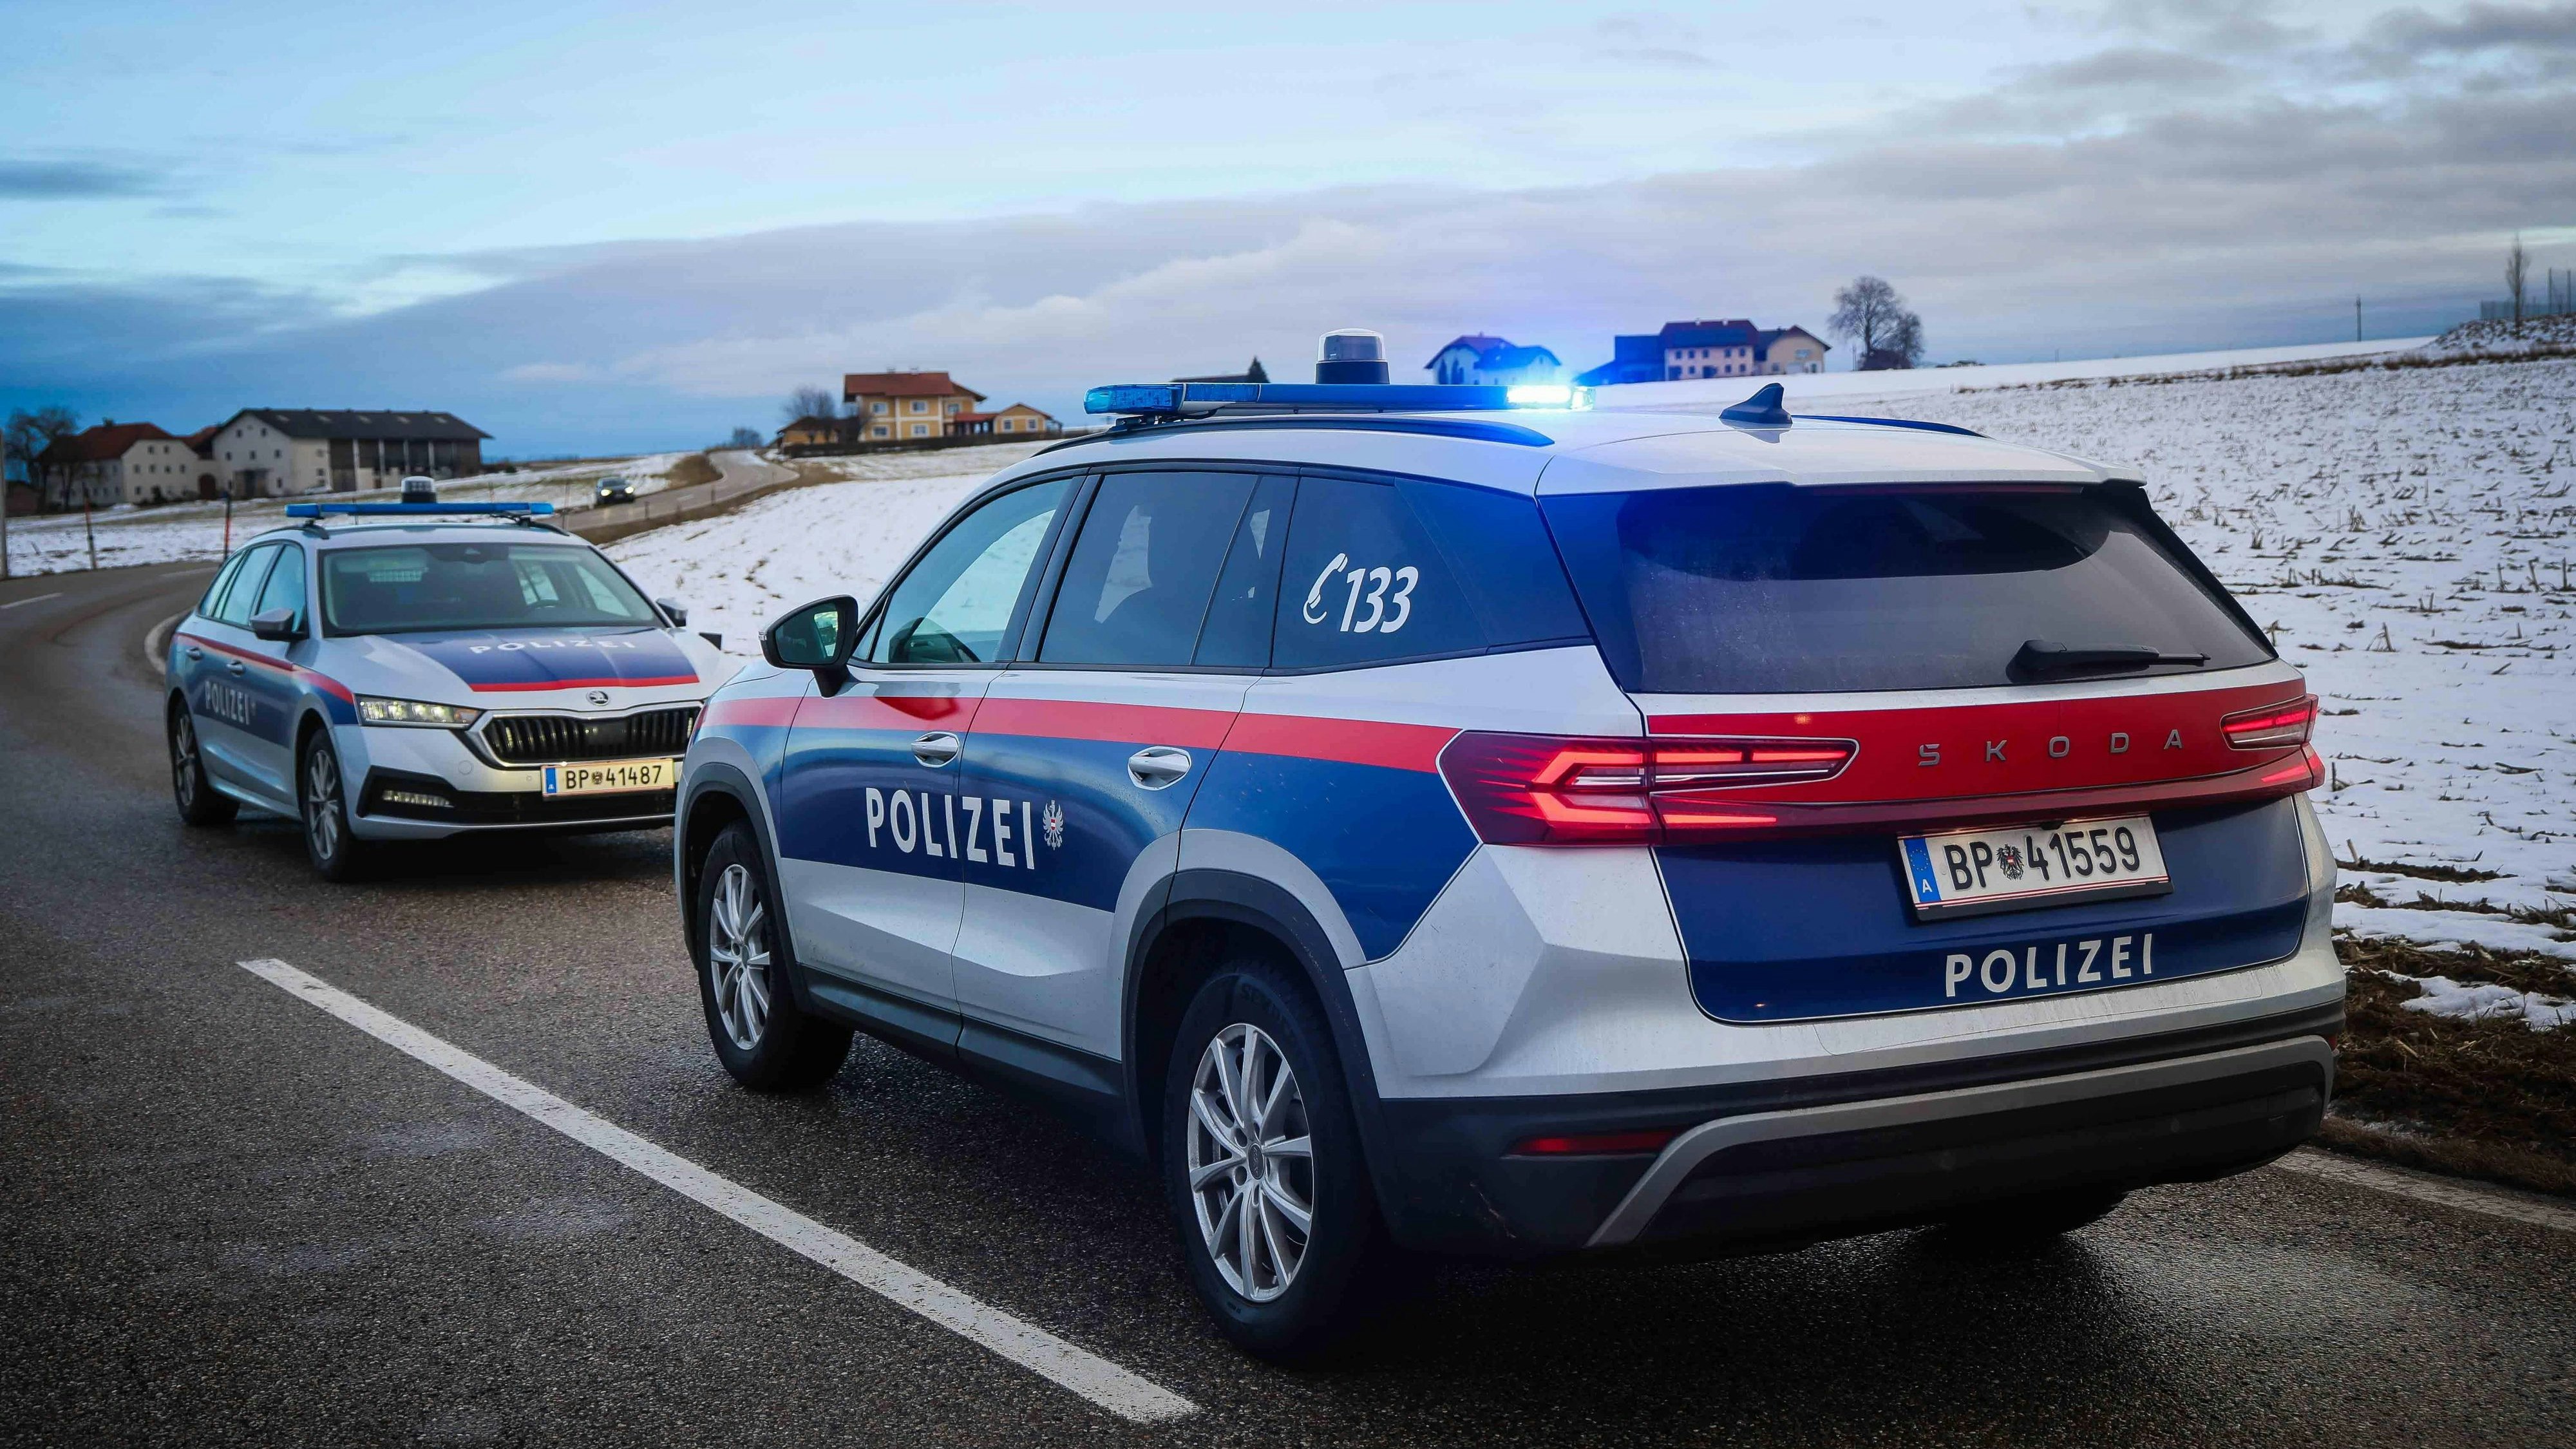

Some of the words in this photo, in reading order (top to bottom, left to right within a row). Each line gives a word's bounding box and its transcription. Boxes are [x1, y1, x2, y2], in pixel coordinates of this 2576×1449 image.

[1340, 565, 1419, 633] 133
[469, 640, 636, 654] POLIZEI
[205, 681, 250, 726] POLIZEI
[1917, 728, 2184, 767] SKODA
[565, 769, 589, 790] BP
[605, 765, 662, 786] 41487
[866, 787, 1035, 870] POLIZEI
[1943, 841, 1993, 891] BP
[2024, 826, 2141, 882] 41559
[1921, 878, 1933, 893] A
[1945, 933, 2153, 998] POLIZEI
